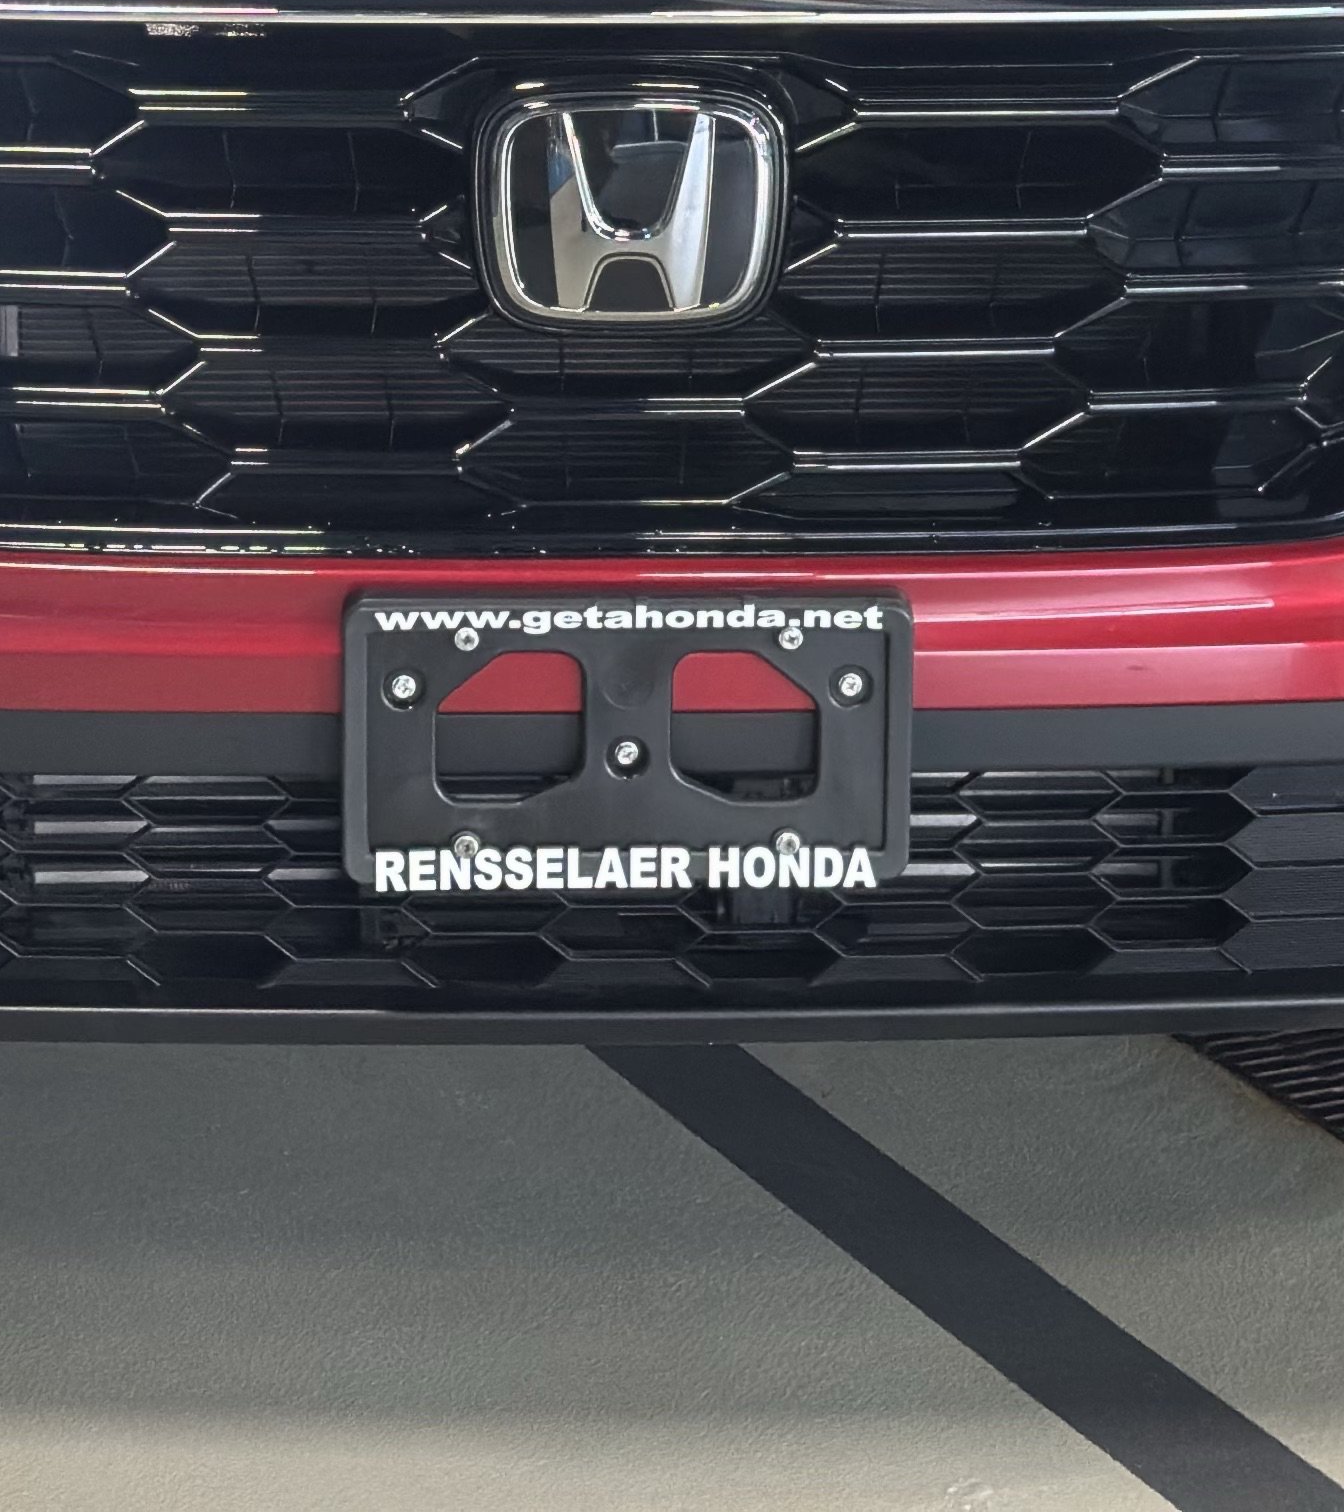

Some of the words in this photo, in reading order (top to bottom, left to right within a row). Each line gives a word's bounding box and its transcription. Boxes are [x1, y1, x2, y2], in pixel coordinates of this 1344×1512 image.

[374, 603, 884, 635] www.getahonda.net
[375, 846, 693, 892] RENSSELAER
[708, 846, 877, 889] HONDA
